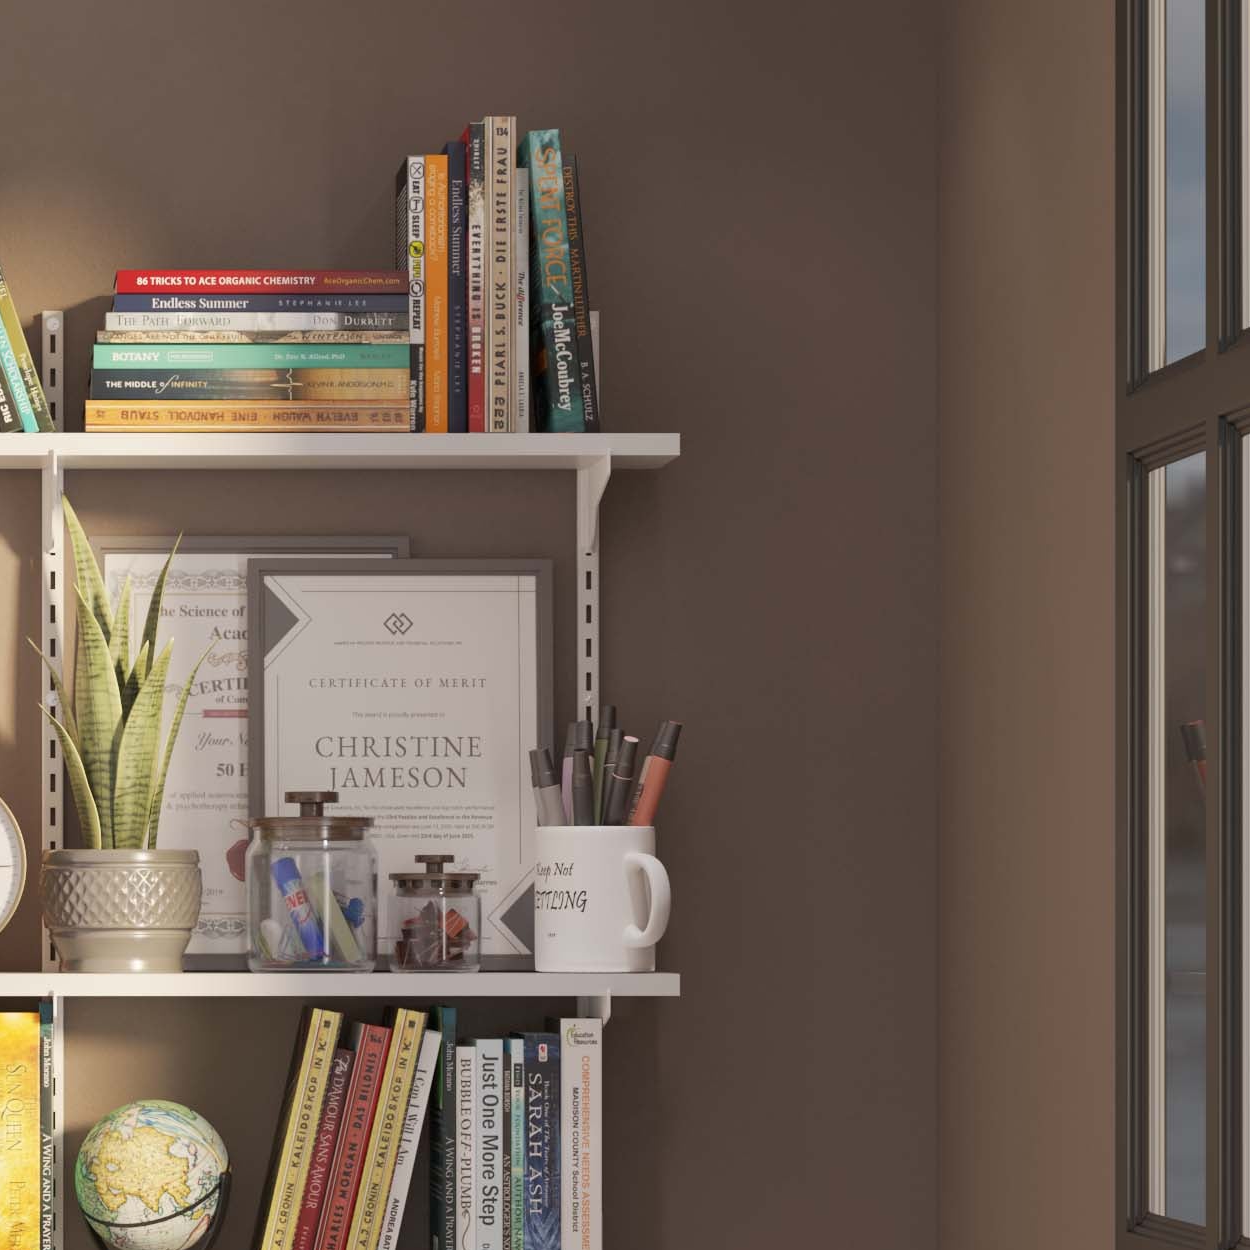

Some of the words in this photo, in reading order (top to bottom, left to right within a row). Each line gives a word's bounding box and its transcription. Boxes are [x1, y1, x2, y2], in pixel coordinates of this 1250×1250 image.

[494, 147, 507, 185] FRAU
[535, 147, 560, 212] SPENT
[412, 181, 421, 194] EAT
[451, 179, 463, 224] Endless
[412, 215, 421, 238] SLEEP
[494, 191, 507, 232] ERSTE
[451, 226, 463, 277] Summer
[494, 239, 507, 263] DIE
[540, 217, 567, 288] FORCE
[135, 276, 148, 286] 86
[150, 276, 182, 286] TRICKS
[184, 276, 195, 286] TO
[197, 276, 216, 286] ACE
[218, 276, 261, 286] ORGANIC
[263, 276, 316, 286] CHEMISTRY
[152, 298, 196, 309] Endless
[198, 298, 249, 309] Summer
[412, 299, 421, 330] REPEAT
[494, 282, 507, 320] BUCK
[494, 326, 507, 336] S.
[111, 352, 160, 362] BOTANY
[494, 342, 507, 386] PEARL
[0, 403, 12, 423] RIC
[160, 605, 176, 618] he
[179, 605, 228, 618] Science
[231, 605, 246, 618] of
[308, 677, 407, 689] CERTIFICATE
[414, 677, 432, 689] OF
[438, 677, 487, 689] MERIT
[314, 735, 483, 759] CHRISTINE
[216, 762, 235, 778] 50
[329, 766, 468, 790] JAMESON
[554, 862, 575, 877] Not
[357, 1051, 379, 1101] BILDNIS
[479, 1053, 500, 1091] Just
[352, 1103, 366, 1129] DAS
[479, 1094, 500, 1129] One
[529, 1072, 543, 1158] SARAH
[572, 1087, 580, 1129] MADISON
[582, 1055, 591, 1148] COMPREHENSIVE
[41, 1142, 52, 1177] WING
[479, 1135, 500, 1180] More
[572, 1130, 580, 1168] COUNTY
[335, 1141, 361, 1199] MORGAN
[572, 1169, 580, 1201] School
[582, 1151, 591, 1189] NEEDS
[41, 1177, 52, 1203] AND
[479, 1184, 500, 1226] Step
[529, 1164, 543, 1216] ASH
[41, 1203, 52, 1214] A
[385, 1197, 400, 1231] ANDREA
[572, 1201, 580, 1233] District
